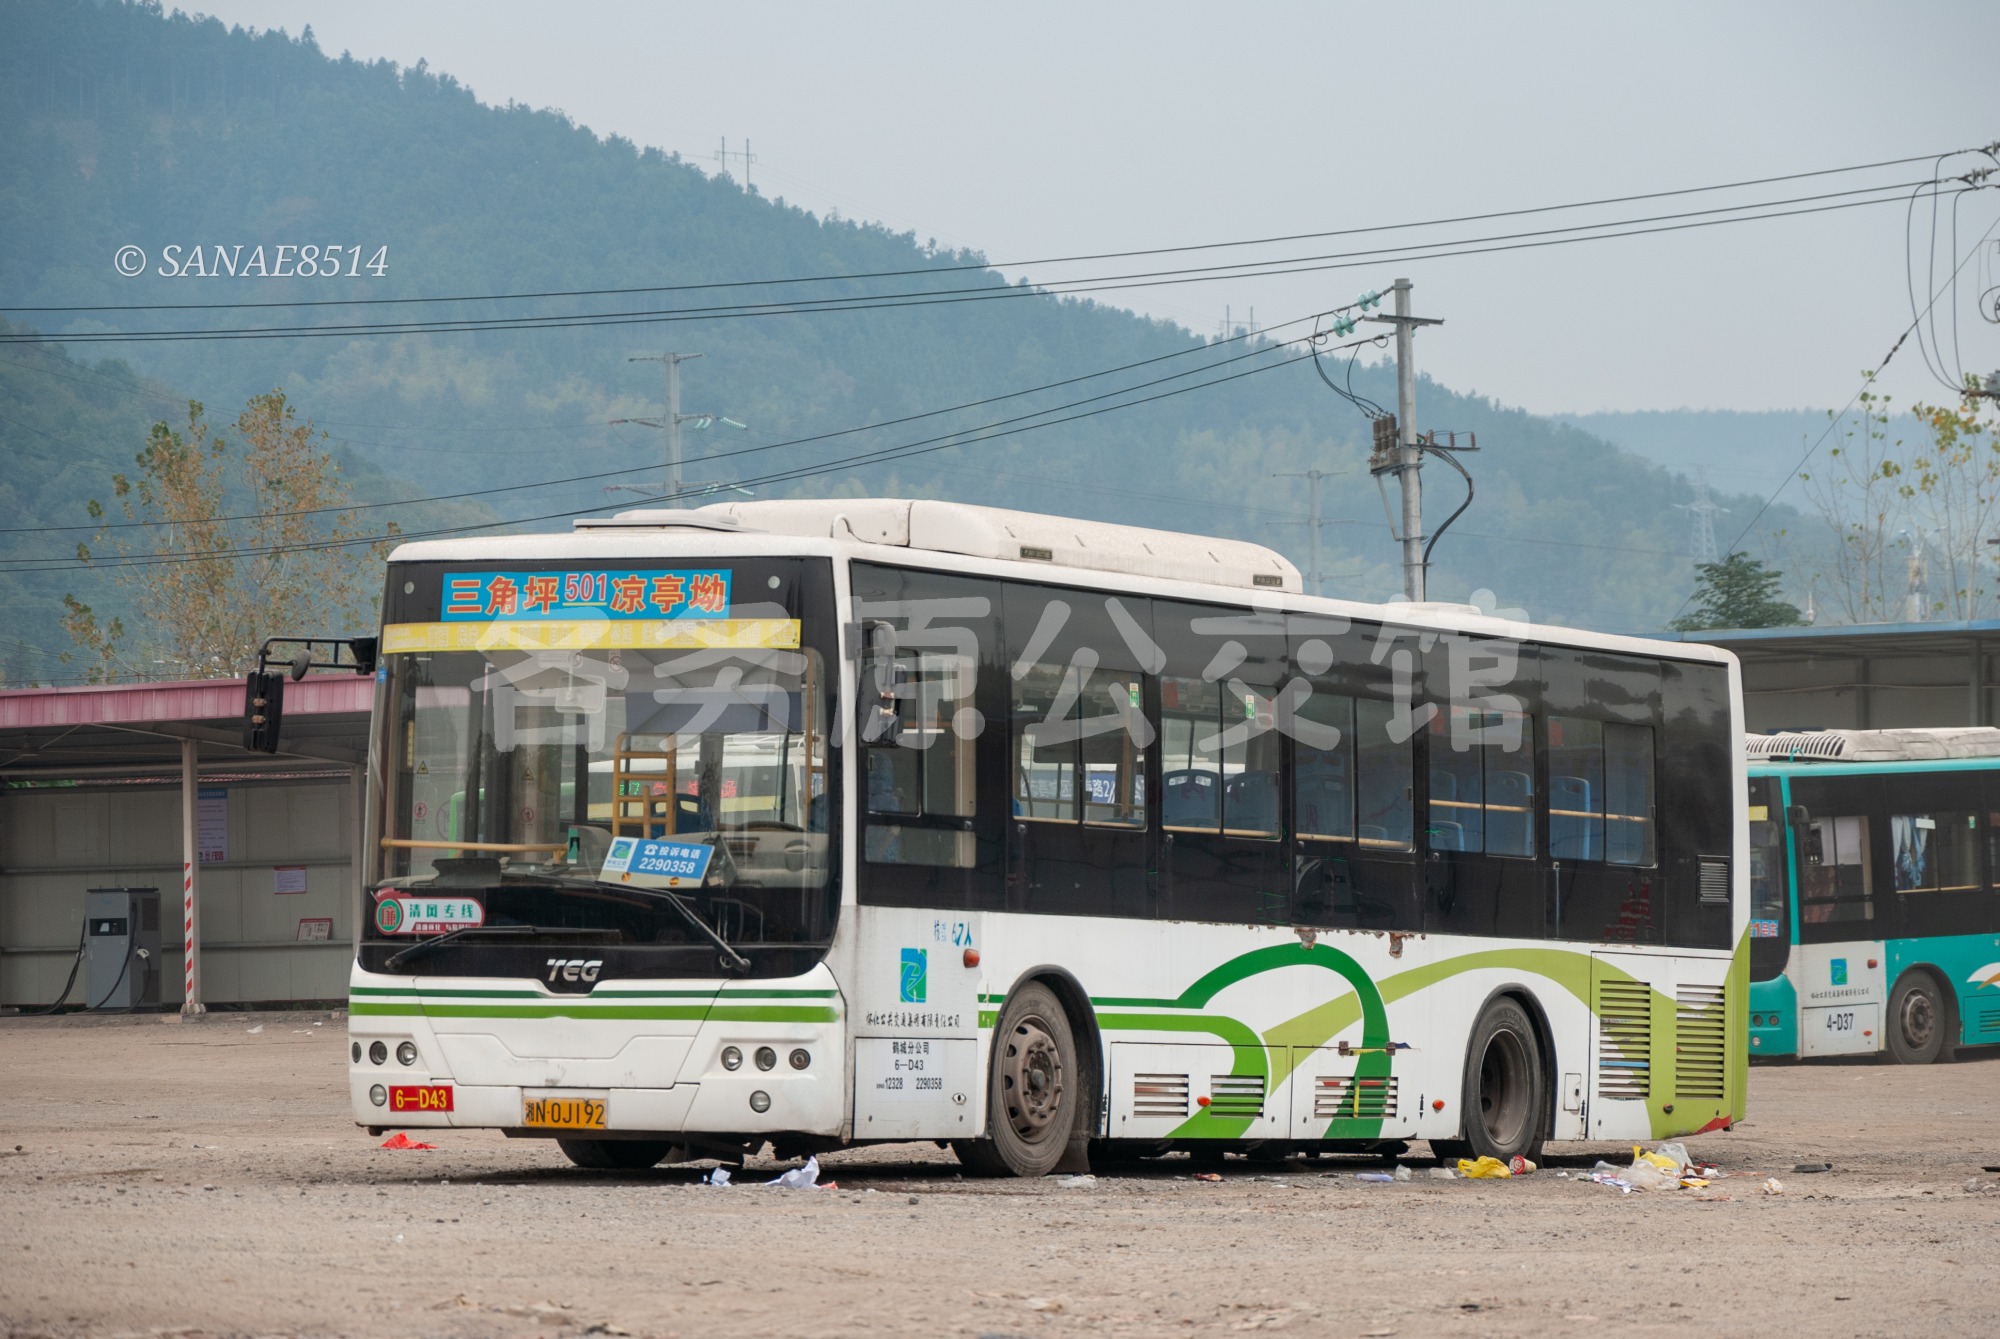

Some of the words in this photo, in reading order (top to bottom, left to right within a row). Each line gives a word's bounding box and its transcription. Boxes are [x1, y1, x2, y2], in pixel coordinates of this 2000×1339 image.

[447, 575, 560, 615] 三角坪
[564, 572, 608, 602] 501
[609, 574, 728, 614] 凉亭坳
[659, 845, 702, 860] 投诉电话
[638, 856, 696, 875] 2290358
[409, 903, 474, 919] 清风专线
[546, 958, 603, 982] TEG
[1826, 1012, 1854, 1031] 4-D37
[885, 1077, 903, 1090] 12328
[916, 1077, 943, 1090] 2290358
